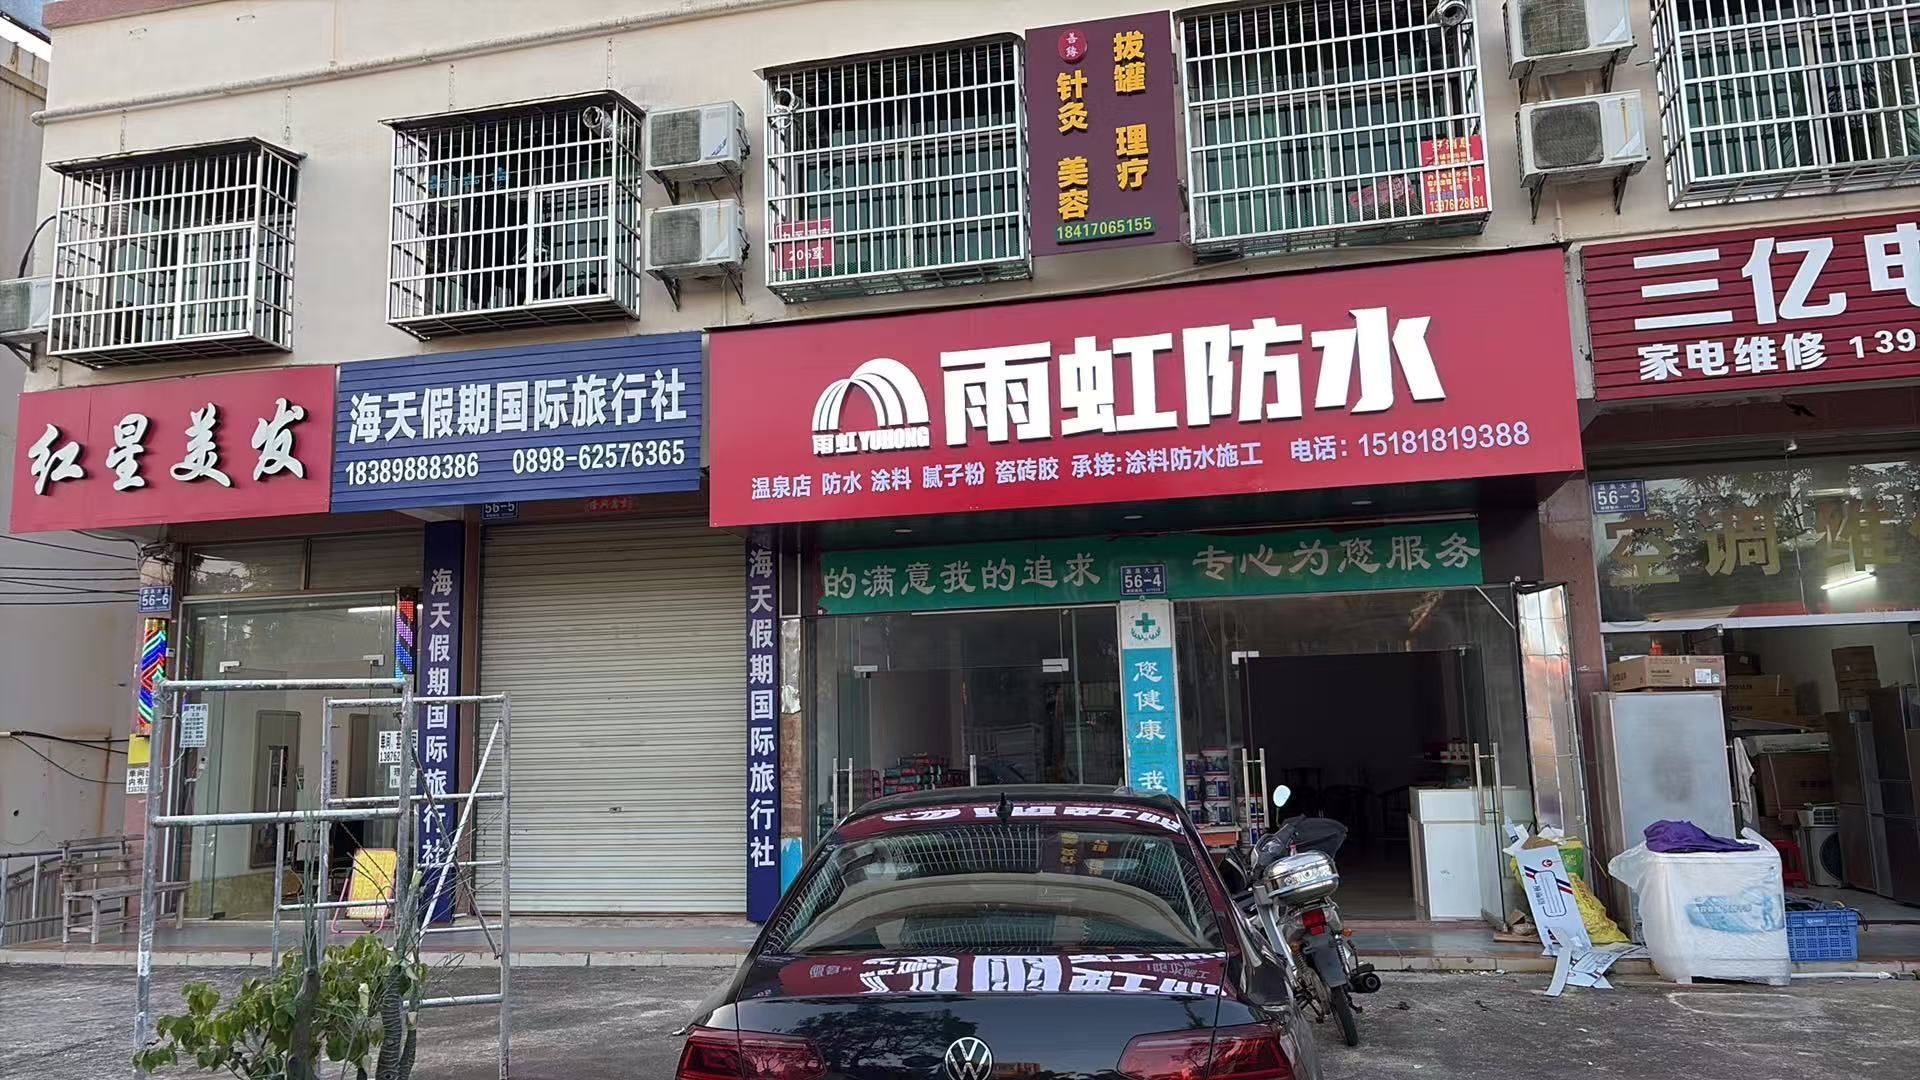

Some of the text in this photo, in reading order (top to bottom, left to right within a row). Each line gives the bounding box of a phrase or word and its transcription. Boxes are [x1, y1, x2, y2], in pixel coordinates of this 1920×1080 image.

[1056, 70, 1089, 220] 针灸 美容
[1113, 30, 1149, 190] 拔罐 理疗
[1057, 217, 1152, 240] 18417065155
[1633, 222, 1920, 331] 三亿电
[940, 307, 1445, 446] 雨虹防水
[1637, 332, 1829, 381] 家电维修
[348, 367, 687, 445] 海天假期国际旅行社
[812, 426, 931, 455] 雨虹 YUHONG
[28, 398, 304, 495] 红星美发
[345, 439, 686, 486] 18389888386 0898-62576365
[751, 475, 812, 501] 温泉店
[821, 471, 863, 497] 防水
[870, 467, 912, 493] 涂料
[922, 462, 985, 490] 腻子粉
[995, 456, 1060, 485] 瓷砖胶
[1357, 421, 1531, 458] 15181819388
[1597, 489, 1641, 505] 56-3
[823, 552, 1101, 599] 的满意我的追求
[1124, 574, 1162, 588] 56-4
[1192, 532, 1481, 581] 专心为您服务
[142, 594, 169, 607] 56-6
[420, 568, 453, 866] 海天假期国际旅行社
[749, 550, 776, 868] 海天假期国际旅行社
[1132, 661, 1166, 740] 您健康
